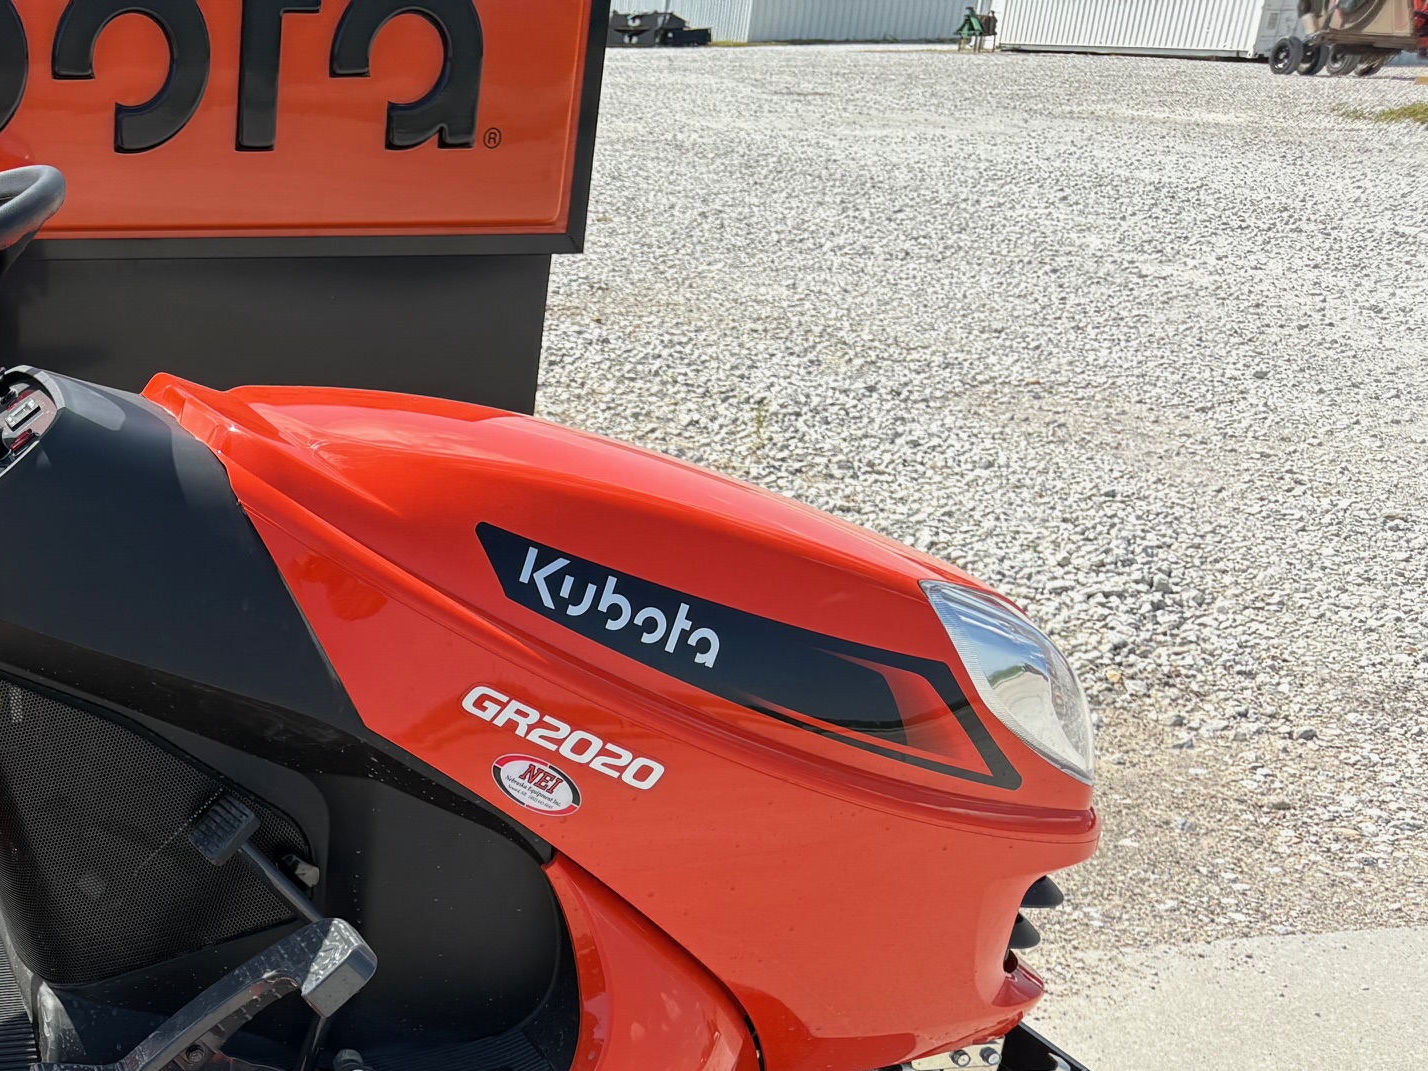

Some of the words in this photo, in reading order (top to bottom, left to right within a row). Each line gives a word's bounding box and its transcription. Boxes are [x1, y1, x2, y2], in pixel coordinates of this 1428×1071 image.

[518, 546, 720, 669] Kubota
[461, 685, 665, 790] GR2020
[505, 775, 528, 789] Nebraska
[528, 786, 553, 803] Equipment
[518, 763, 564, 795] NEI
